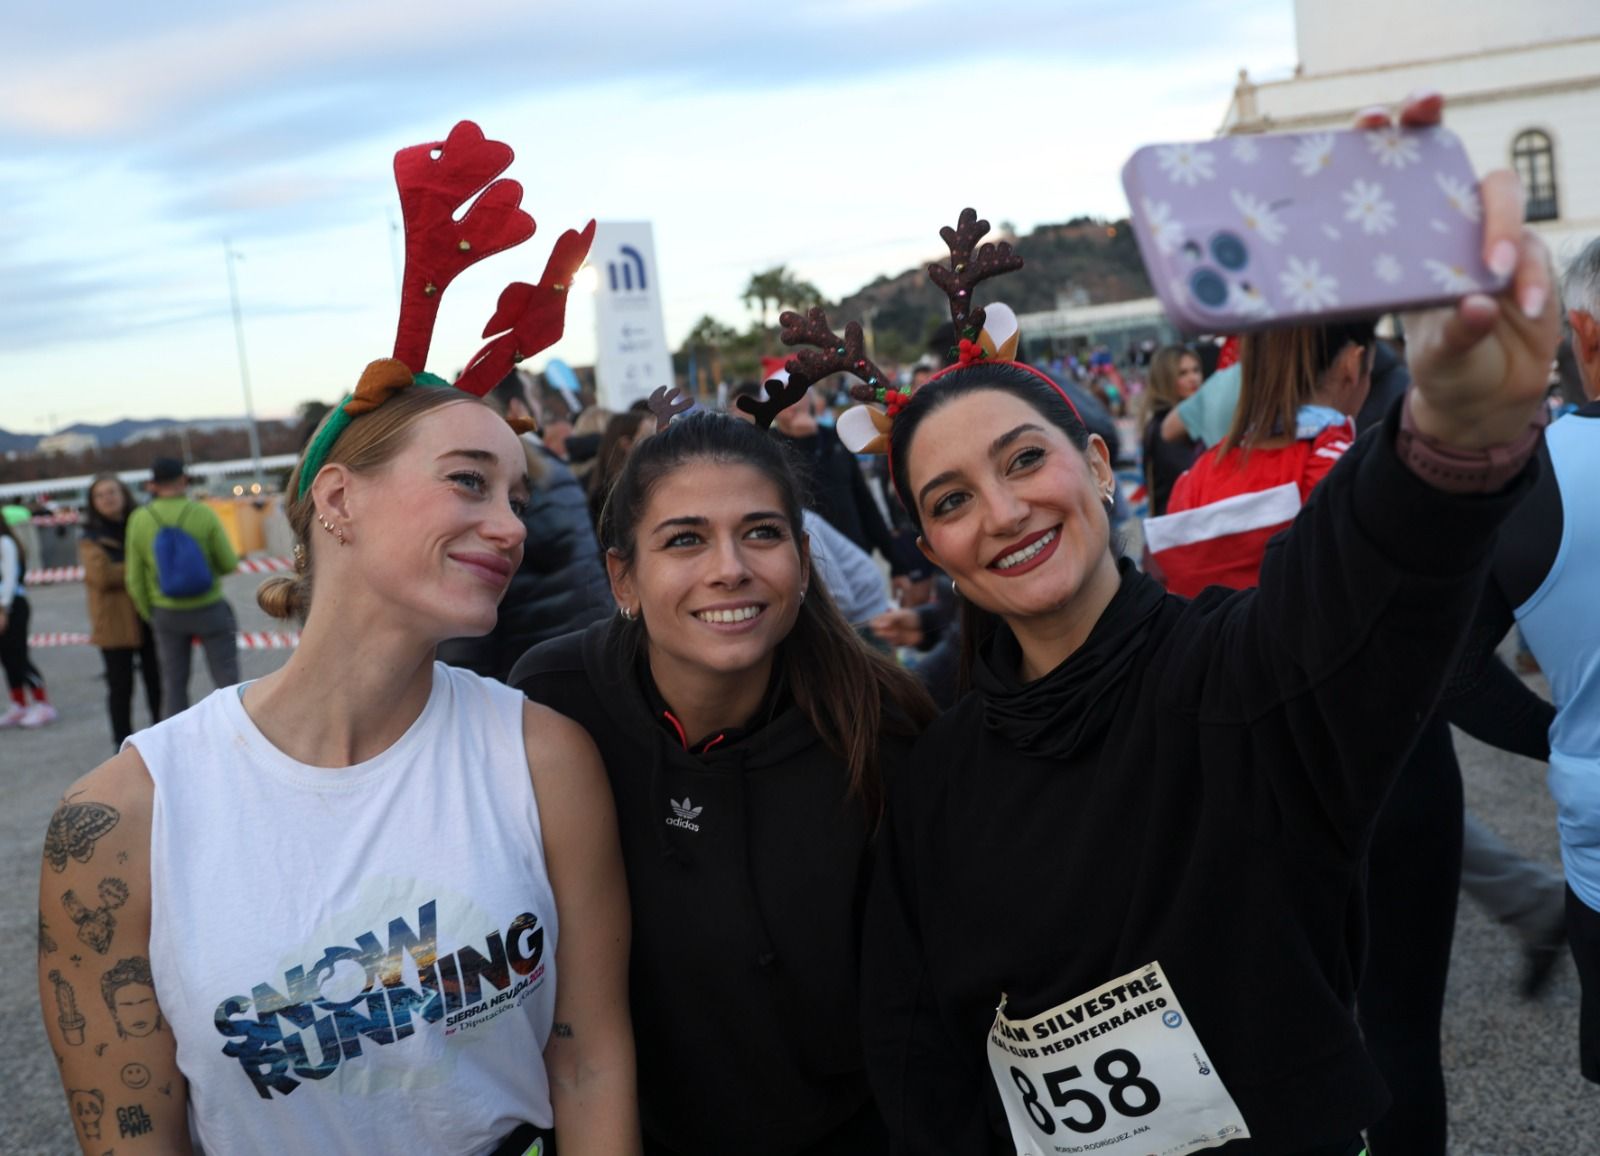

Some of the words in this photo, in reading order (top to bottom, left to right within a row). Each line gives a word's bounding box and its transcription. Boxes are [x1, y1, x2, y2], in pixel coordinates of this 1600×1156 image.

[665, 816, 700, 832] adidas
[214, 899, 437, 1057] SNOW
[237, 912, 544, 1099] RUNNING
[446, 1001, 489, 1027] SIERRA
[490, 978, 530, 1008] NEVADA
[1032, 971, 1163, 1040] SILVESTRE
[1009, 1045, 1040, 1059] CLUB
[1040, 997, 1168, 1057] MEDITERRÁNEO
[116, 1104, 150, 1122] GRL
[1010, 1048, 1161, 1136] 858
[119, 1118, 153, 1139] PWR
[1133, 1124, 1151, 1136] ANA
